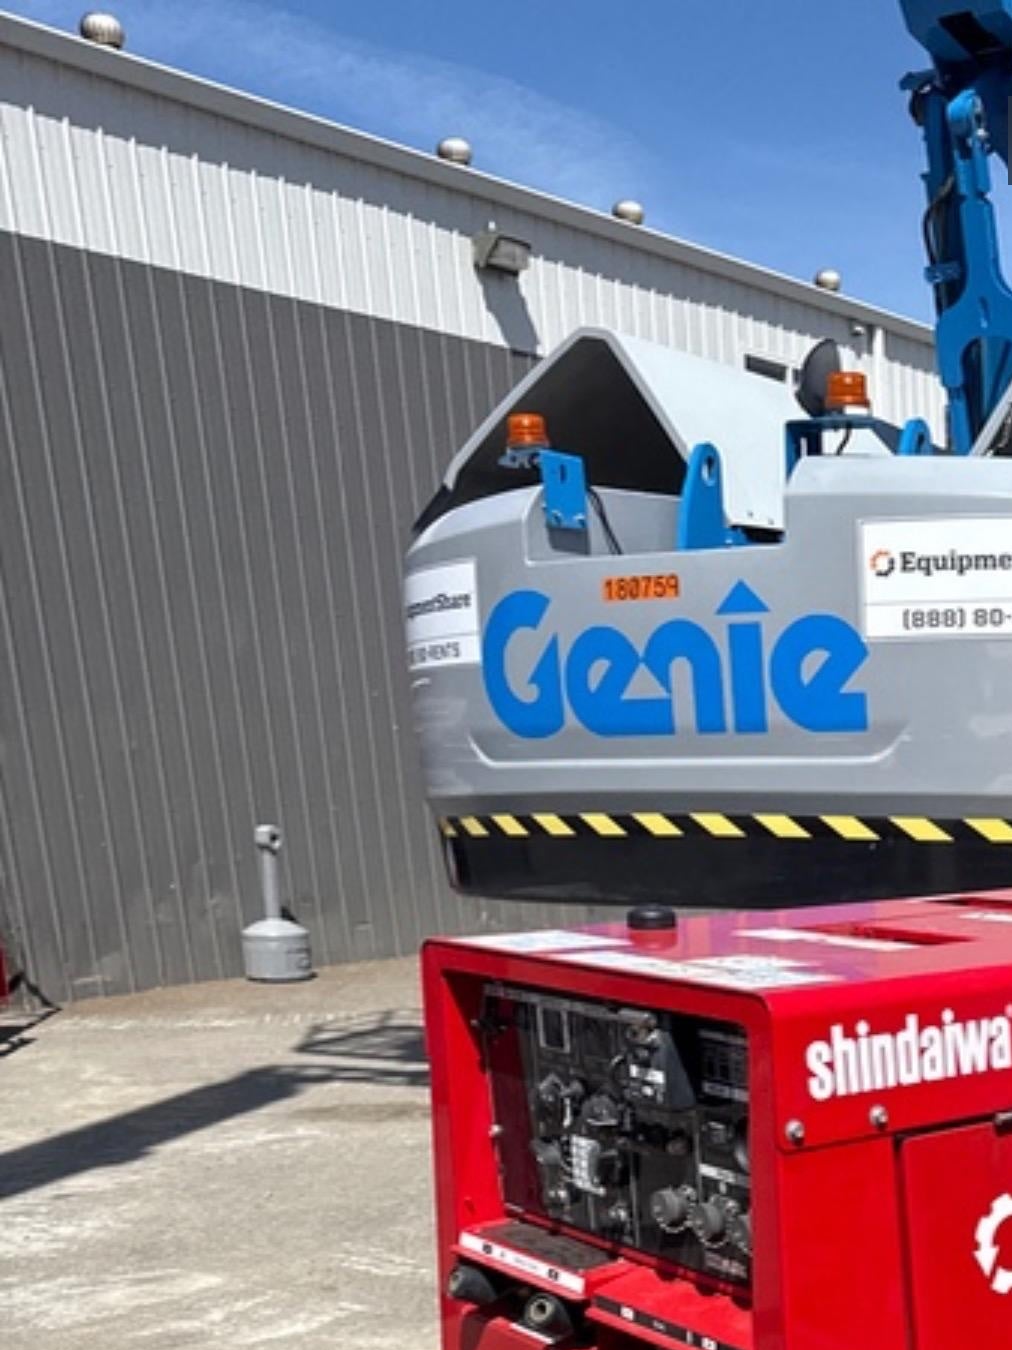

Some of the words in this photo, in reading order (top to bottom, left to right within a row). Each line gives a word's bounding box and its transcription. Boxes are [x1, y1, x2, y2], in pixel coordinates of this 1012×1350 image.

[483, 580, 868, 738] Genie
[902, 608, 966, 630] (888)
[805, 1008, 1012, 1101] shindaiwa
